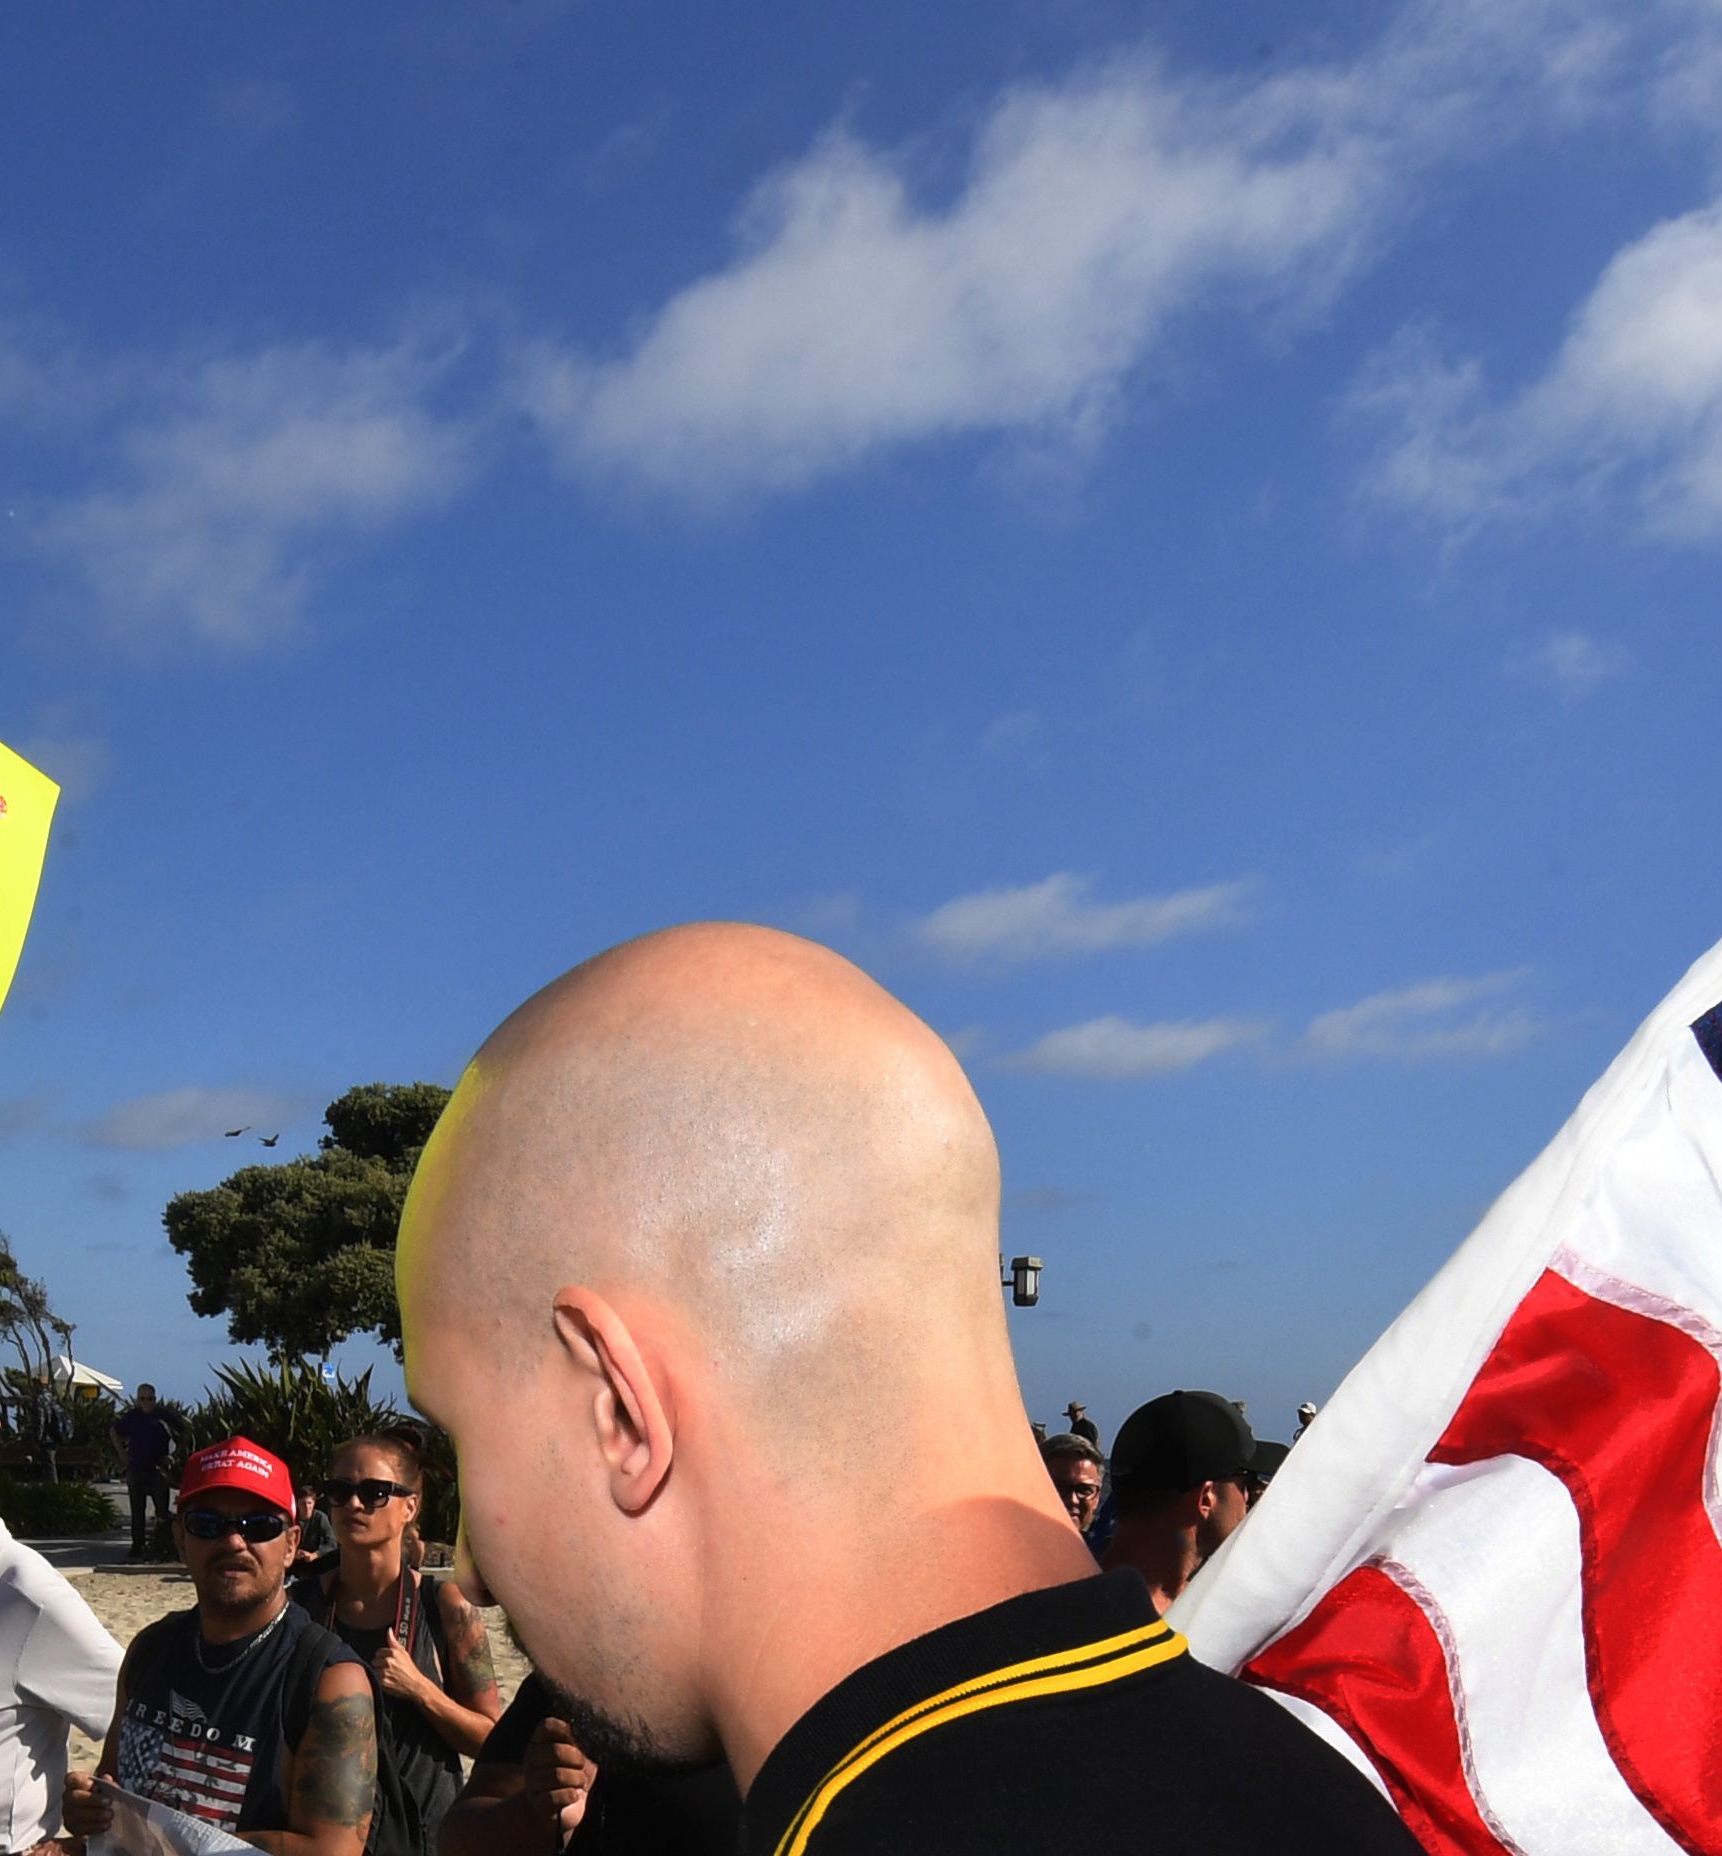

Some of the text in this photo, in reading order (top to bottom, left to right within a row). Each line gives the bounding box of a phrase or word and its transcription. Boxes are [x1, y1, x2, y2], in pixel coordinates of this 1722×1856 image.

[200, 1449, 273, 1473] MAKE AMERICA
[201, 1460, 271, 1479] GREAT AGAIN
